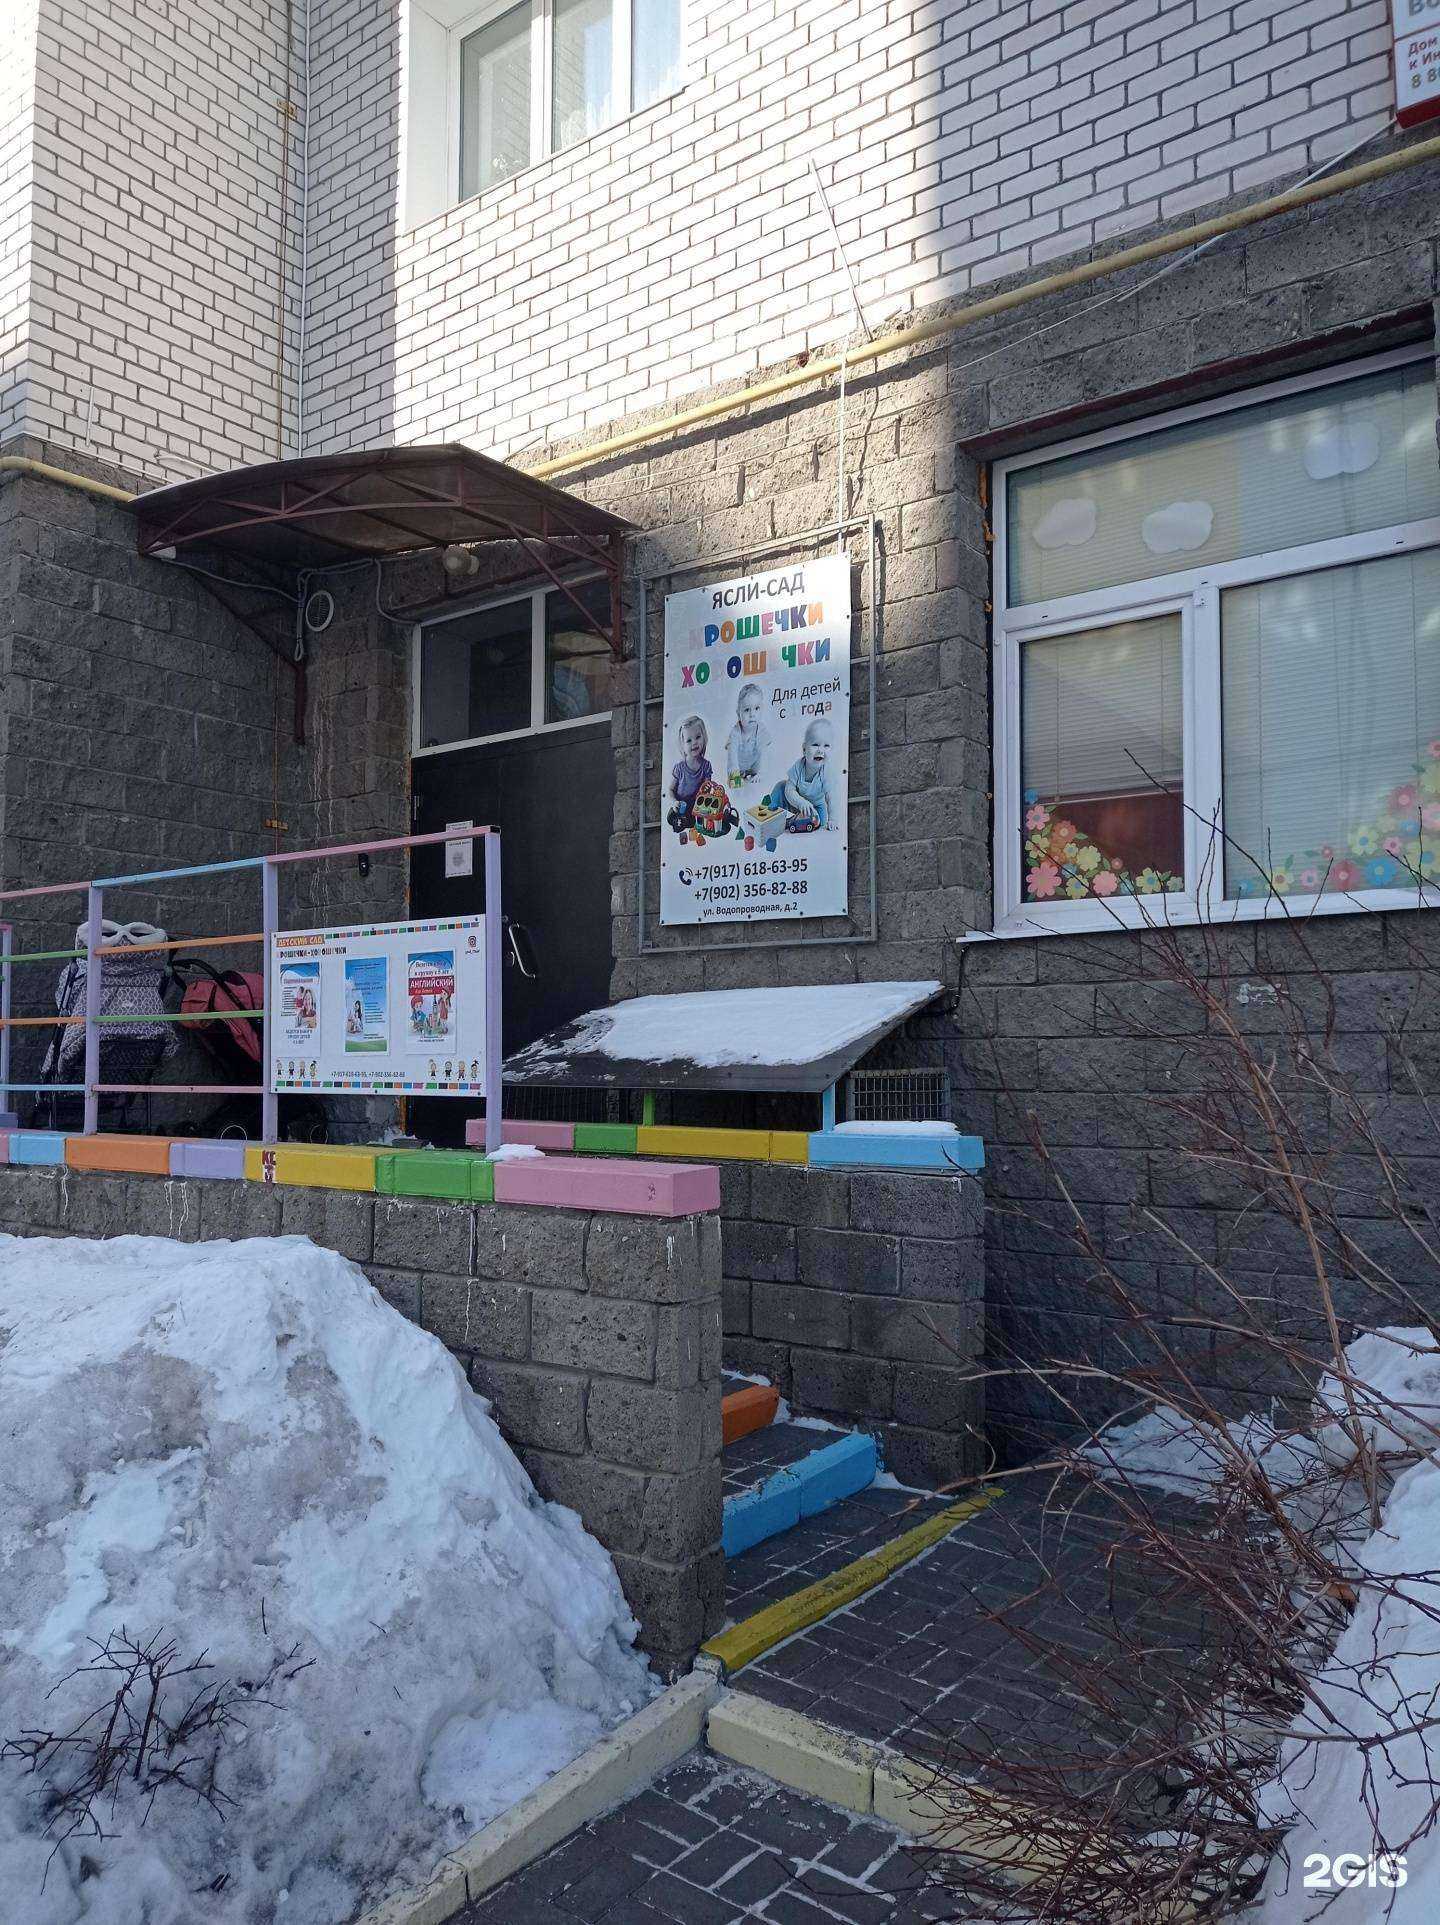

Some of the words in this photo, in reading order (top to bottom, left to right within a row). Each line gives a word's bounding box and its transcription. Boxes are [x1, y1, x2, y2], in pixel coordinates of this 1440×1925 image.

[1411, 73, 1422, 89] 8
[712, 572, 805, 609] ЯСЛИ-САД
[771, 688, 797, 706] Для
[801, 676, 841, 700] детей
[801, 701, 832, 716] года
[694, 862, 740, 881] +7(917)
[744, 858, 808, 876] 618-63-95
[694, 883, 740, 902] +7(902)
[743, 880, 808, 898] 356-82-88
[703, 908, 715, 917] ул.
[716, 902, 783, 915] Водопроводная,
[410, 977, 453, 988] АНГЛИЙСКИЙ
